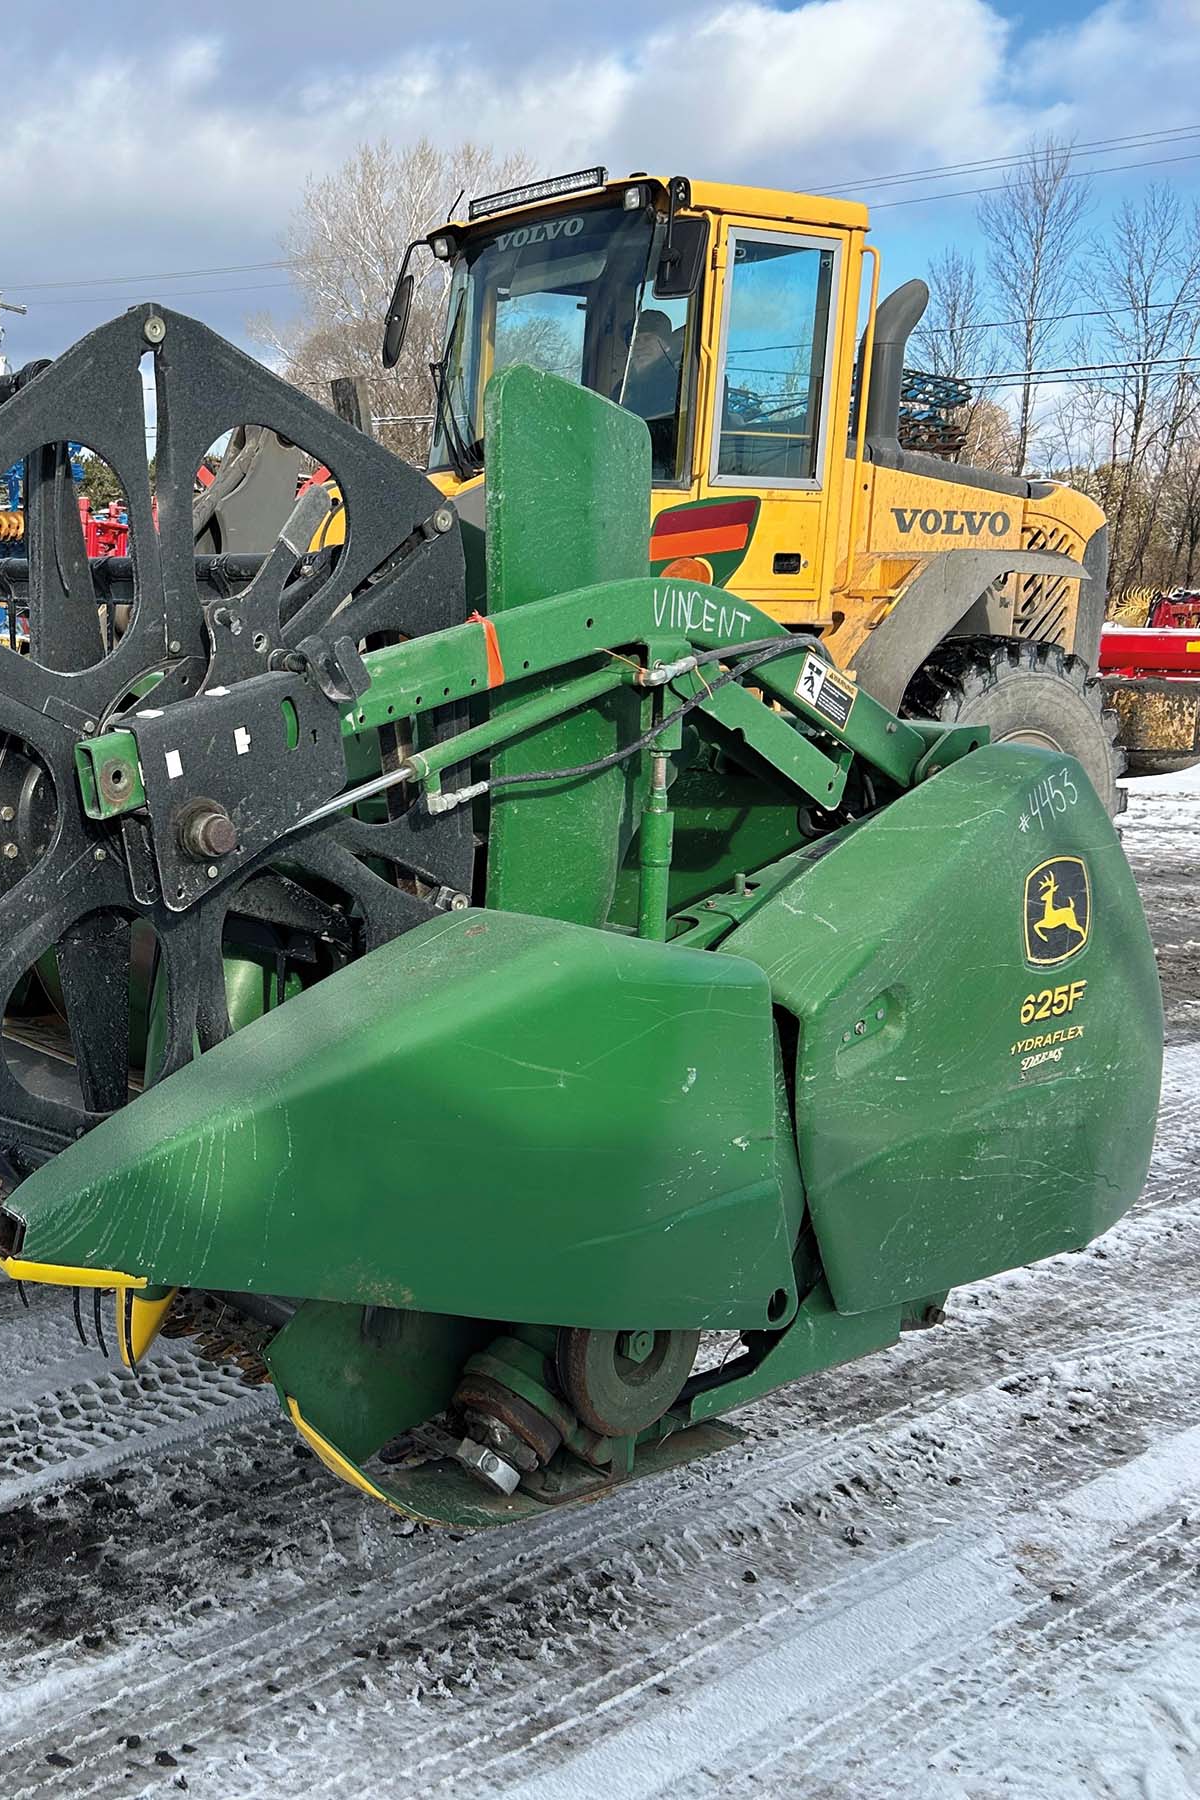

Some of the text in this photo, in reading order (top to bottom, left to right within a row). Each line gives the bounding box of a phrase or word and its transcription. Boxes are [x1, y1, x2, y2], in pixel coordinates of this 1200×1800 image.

[495, 217, 584, 252] VOLVO
[890, 507, 1011, 537] VOLVO
[653, 584, 752, 638] VINCENT
[1018, 767, 1078, 833] #4453
[1020, 979, 1088, 1026] 625F
